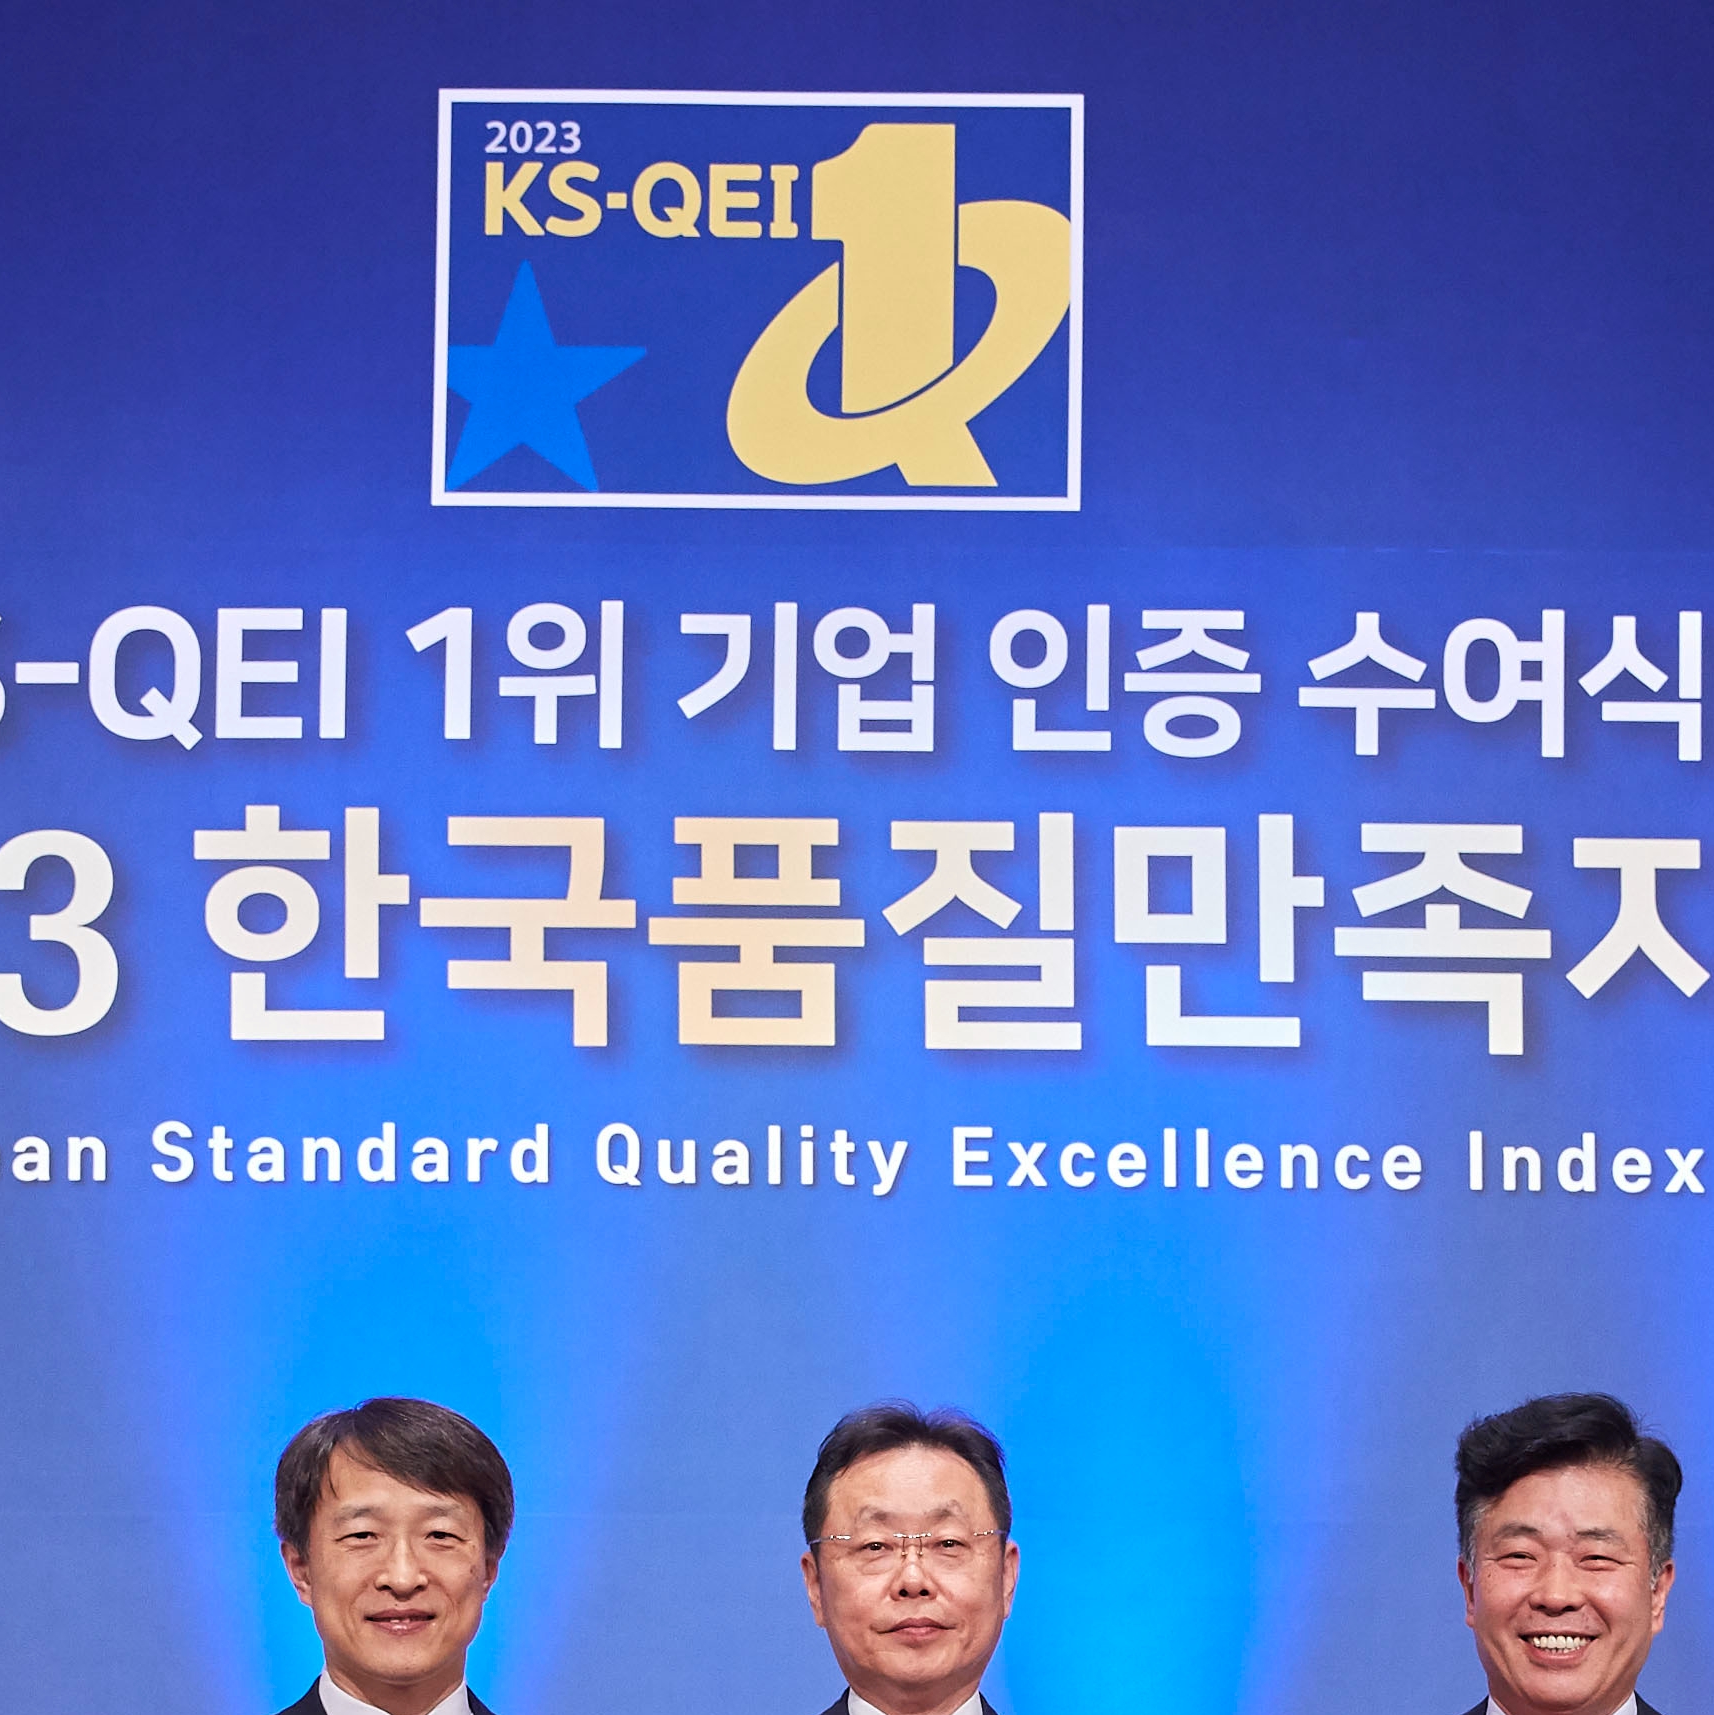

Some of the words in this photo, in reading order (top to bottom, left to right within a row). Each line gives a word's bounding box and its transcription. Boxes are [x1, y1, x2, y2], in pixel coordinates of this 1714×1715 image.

[485, 120, 581, 154] 2023
[484, 160, 800, 239] KS-QEI
[405, 600, 625, 750] 1위
[677, 602, 936, 752] 기업
[989, 604, 1262, 758] 인증
[1297, 609, 1703, 762] 수여식
[150, 1120, 550, 1185] Standard
[595, 1122, 909, 1197] Quality
[951, 1126, 1423, 1191] Excellence
[1469, 1130, 1706, 1194] Index
